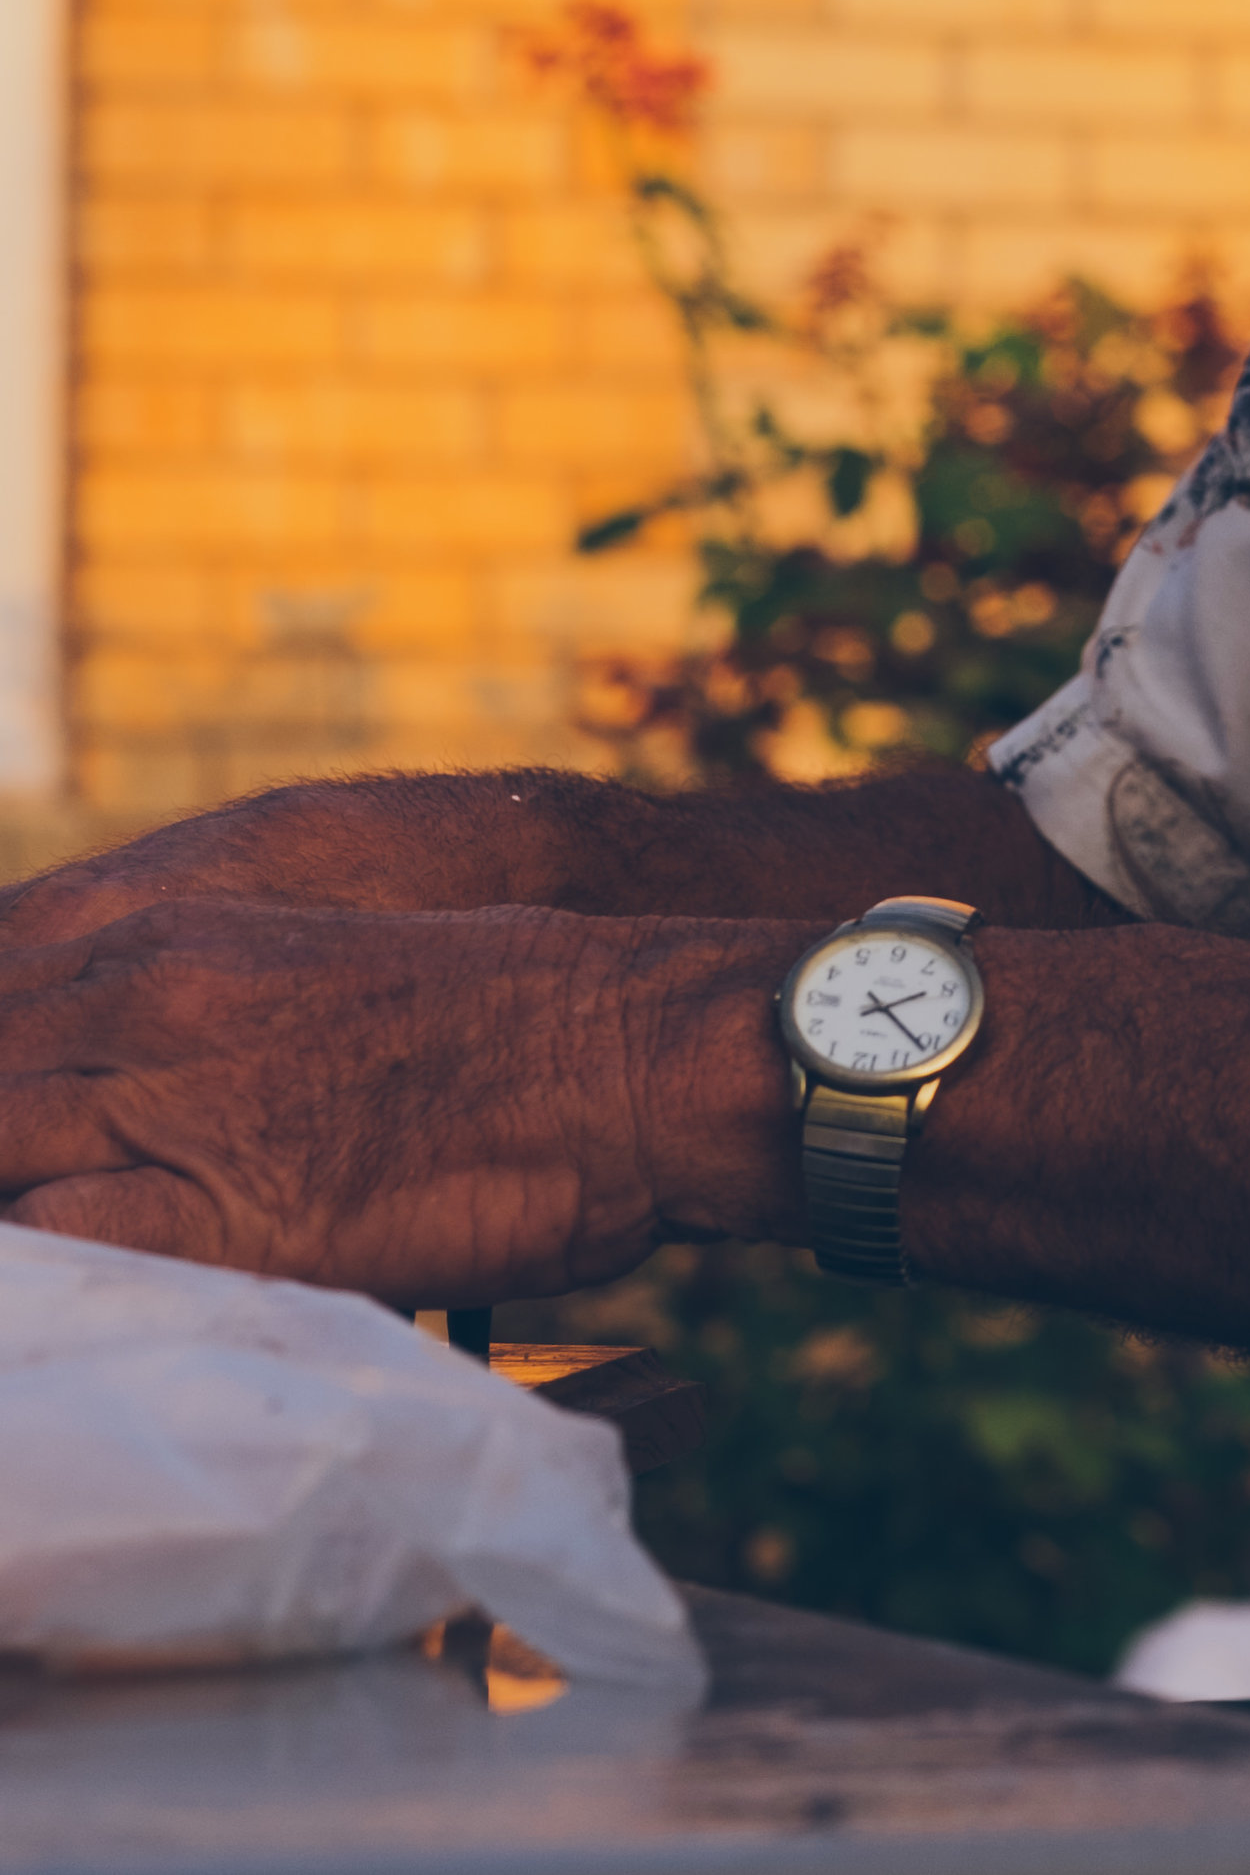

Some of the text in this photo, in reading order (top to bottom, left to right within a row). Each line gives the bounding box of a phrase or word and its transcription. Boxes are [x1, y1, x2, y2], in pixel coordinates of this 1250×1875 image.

[856, 948, 870, 966] 5
[890, 946, 906, 962] 6
[827, 966, 840, 980] 4
[921, 959, 935, 975] 7
[942, 981, 956, 997] 8
[807, 991, 821, 1006] 3
[808, 1018, 824, 1035] 2
[829, 1041, 837, 1057] 1
[917, 1033, 940, 1049] 10
[852, 1051, 877, 1071] 12
[891, 1050, 909, 1068] 11
